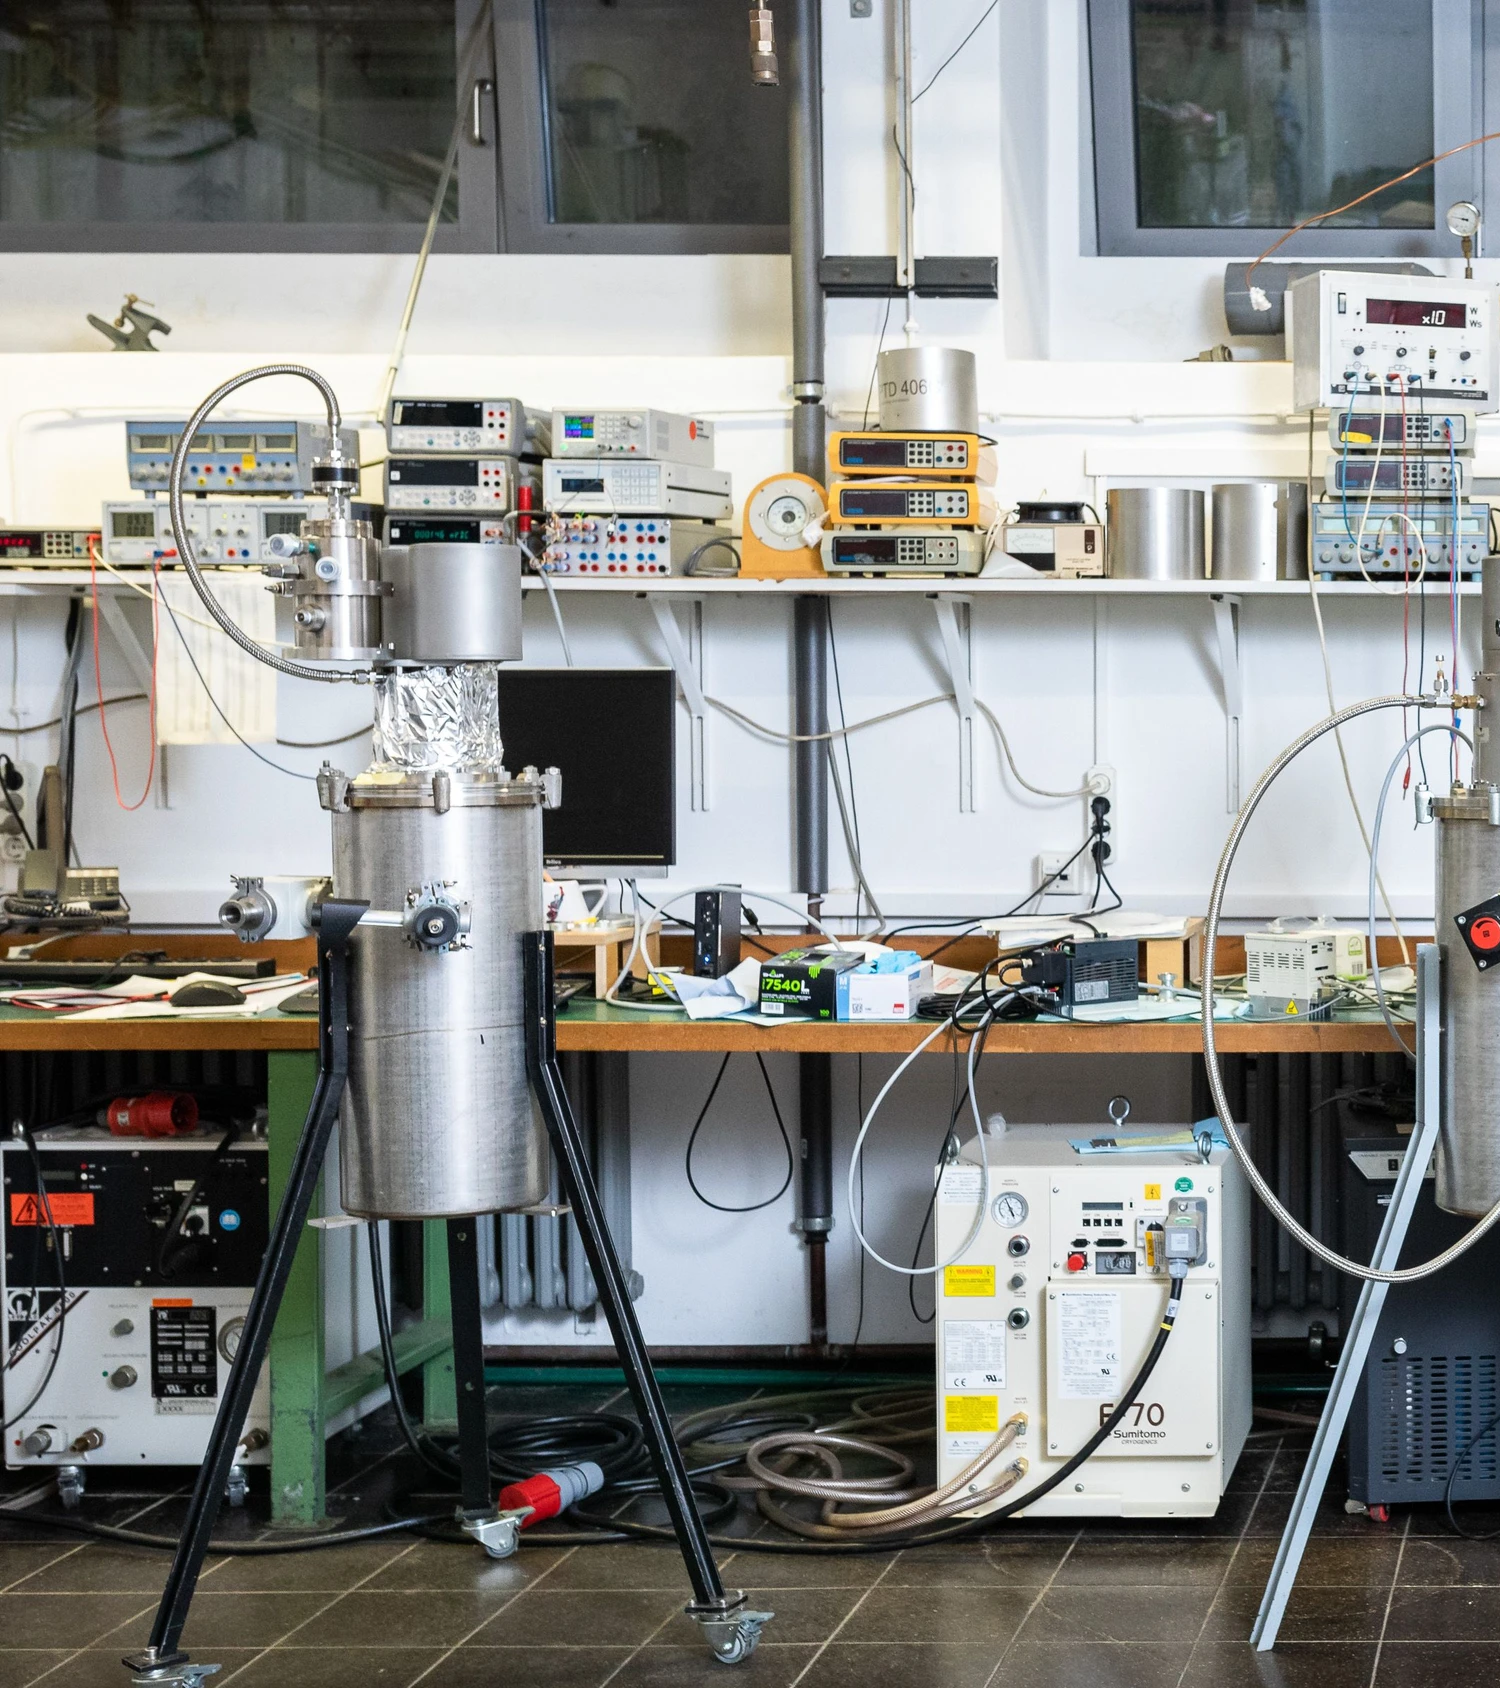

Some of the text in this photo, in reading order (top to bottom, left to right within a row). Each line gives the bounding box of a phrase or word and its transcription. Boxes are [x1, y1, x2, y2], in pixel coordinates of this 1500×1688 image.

[1422, 310, 1446, 325] x10
[1469, 306, 1478, 316] W
[900, 379, 928, 396] 406
[765, 978, 800, 993] 7540
[1113, 1429, 1166, 1439] Sumitomo
